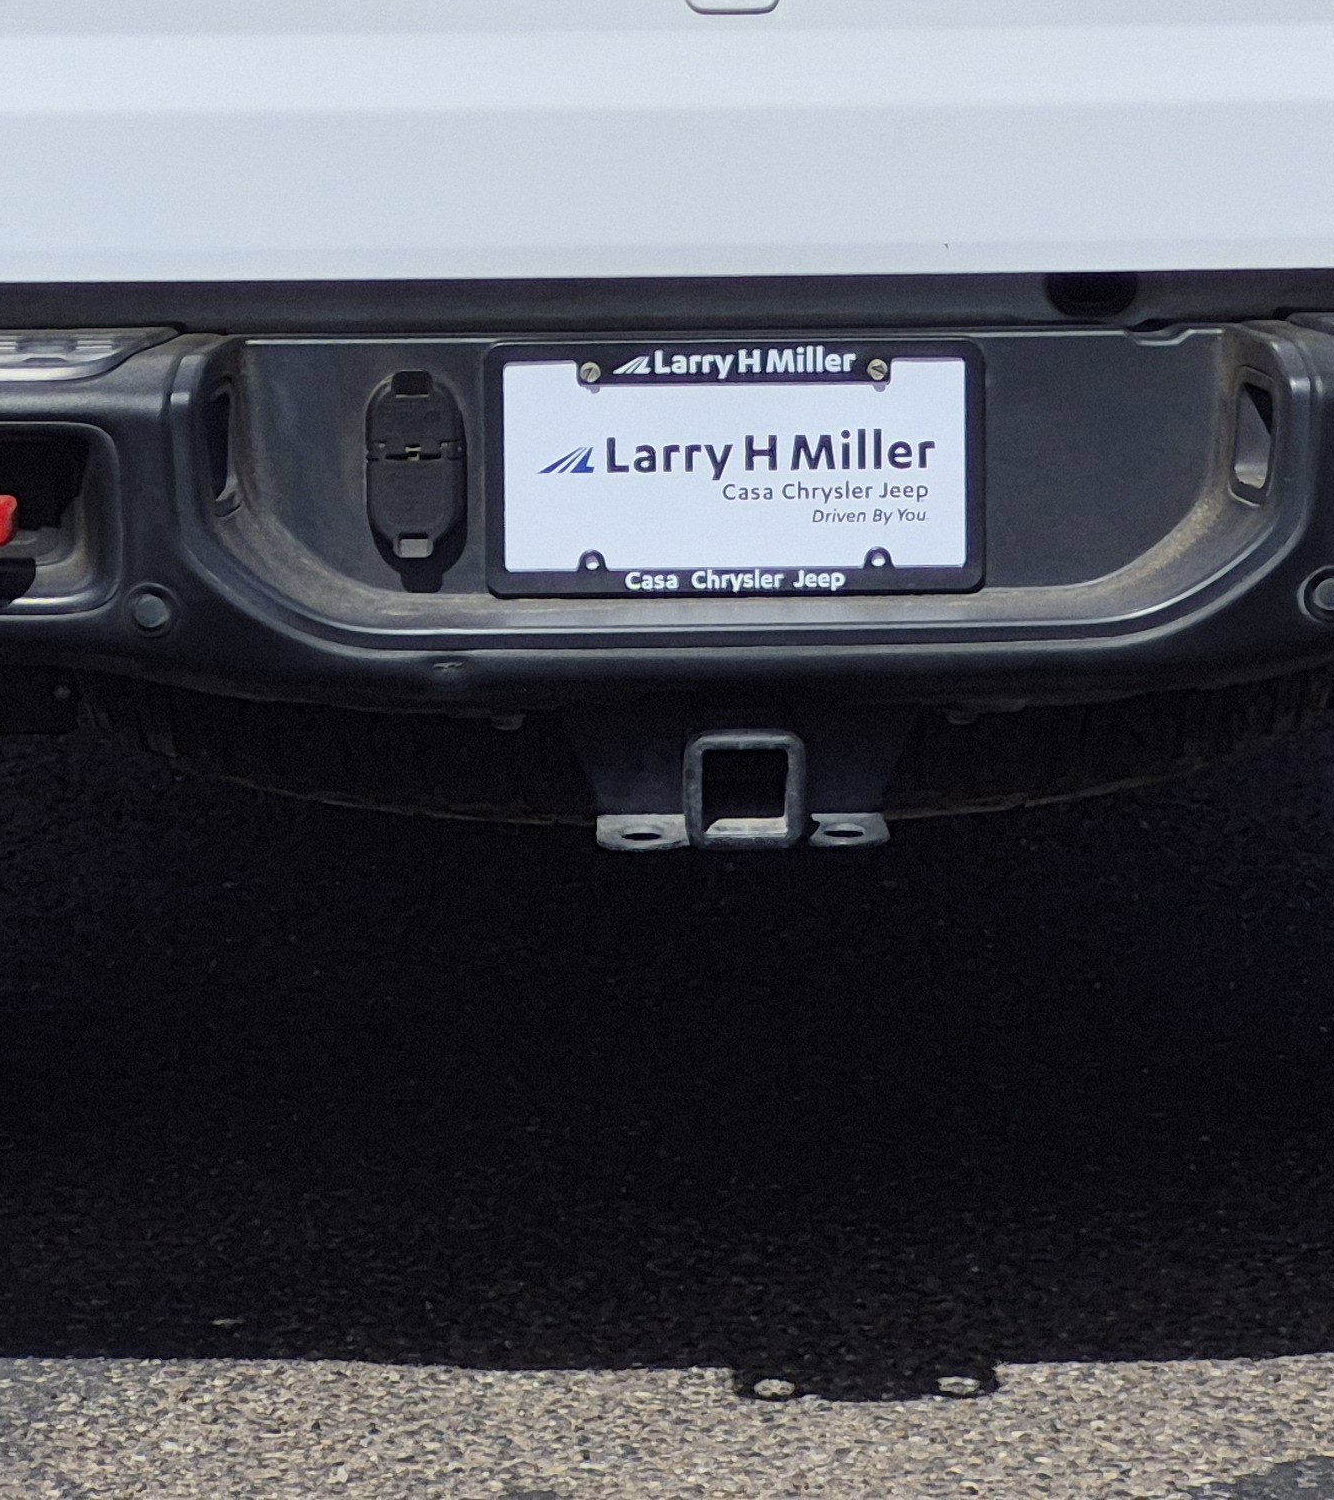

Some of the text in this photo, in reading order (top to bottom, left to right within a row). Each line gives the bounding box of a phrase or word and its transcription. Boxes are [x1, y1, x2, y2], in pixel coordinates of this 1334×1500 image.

[653, 346, 857, 380] Larry H Miller
[605, 429, 937, 481] Larry H Miller
[722, 480, 930, 504] Casa Chrysler Jeep
[811, 508, 867, 524] Driven
[872, 508, 893, 526] By
[624, 569, 847, 593] Casa Chrysler Jeep
